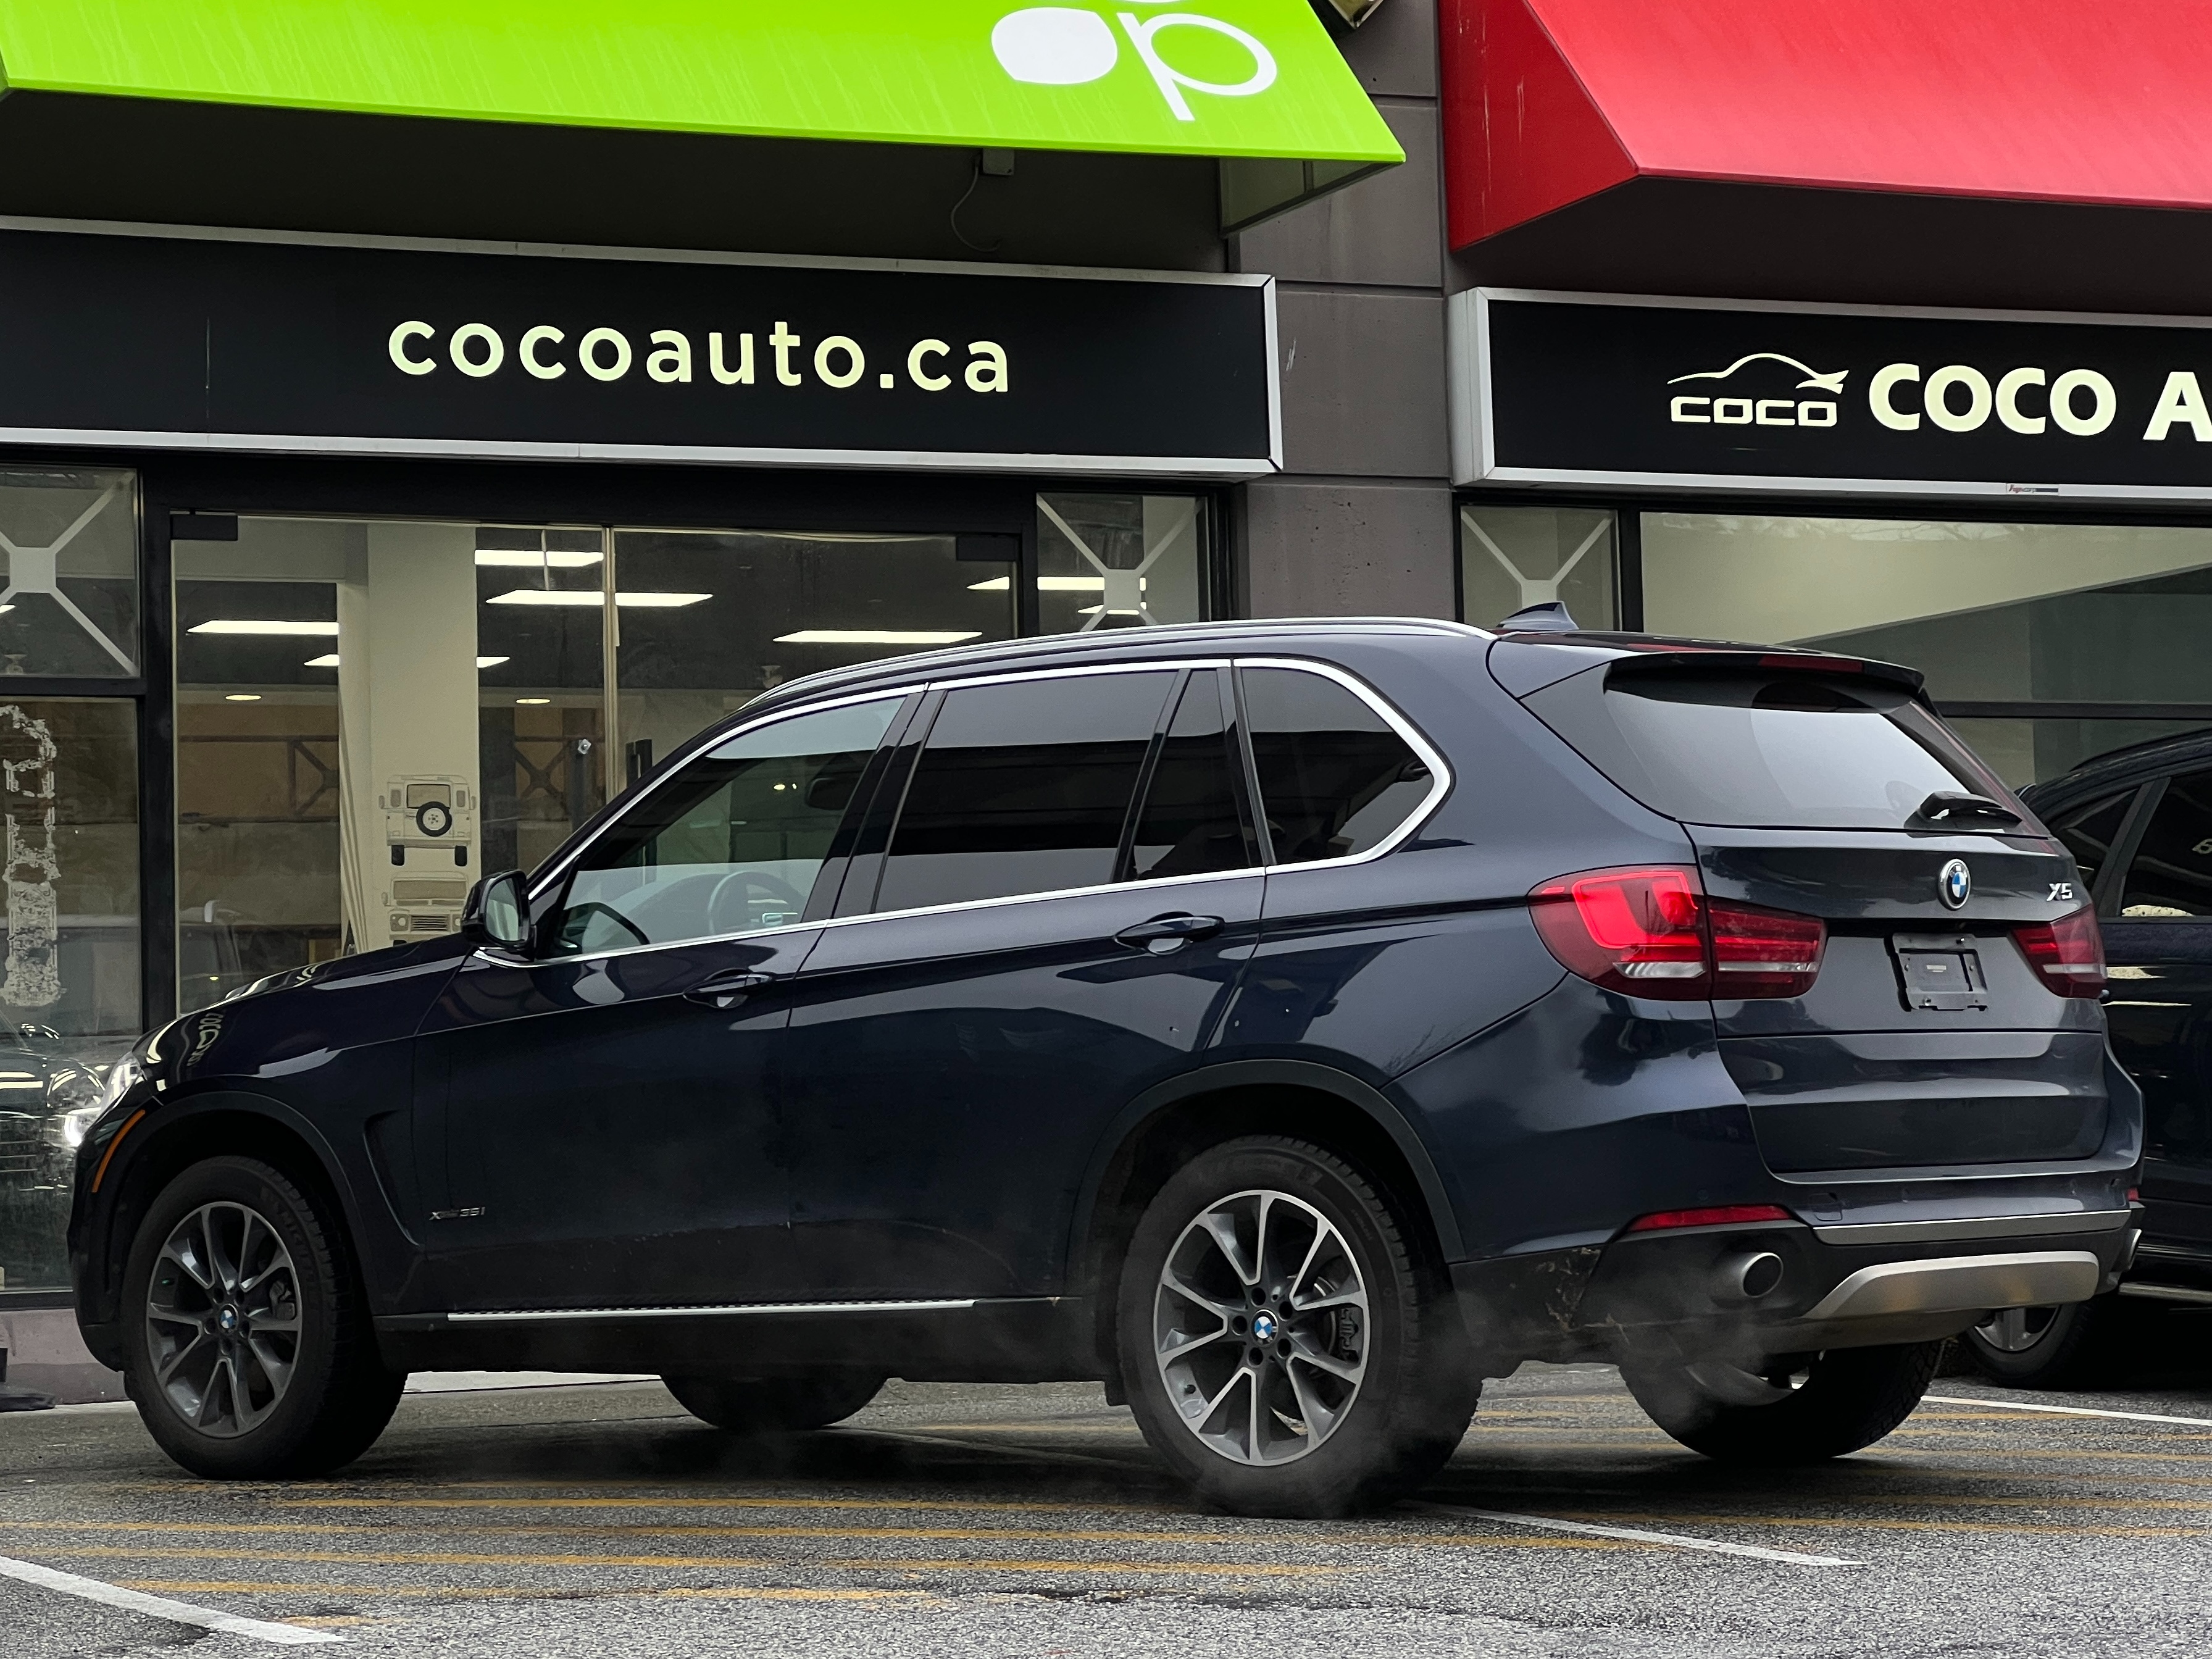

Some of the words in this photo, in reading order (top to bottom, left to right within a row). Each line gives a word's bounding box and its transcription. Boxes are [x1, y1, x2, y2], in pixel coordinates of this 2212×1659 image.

[389, 321, 1008, 393] cocoauto.ca
[1671, 396, 1837, 427] COCO
[1869, 363, 2117, 437] COCO
[2046, 882, 2073, 901] X5
